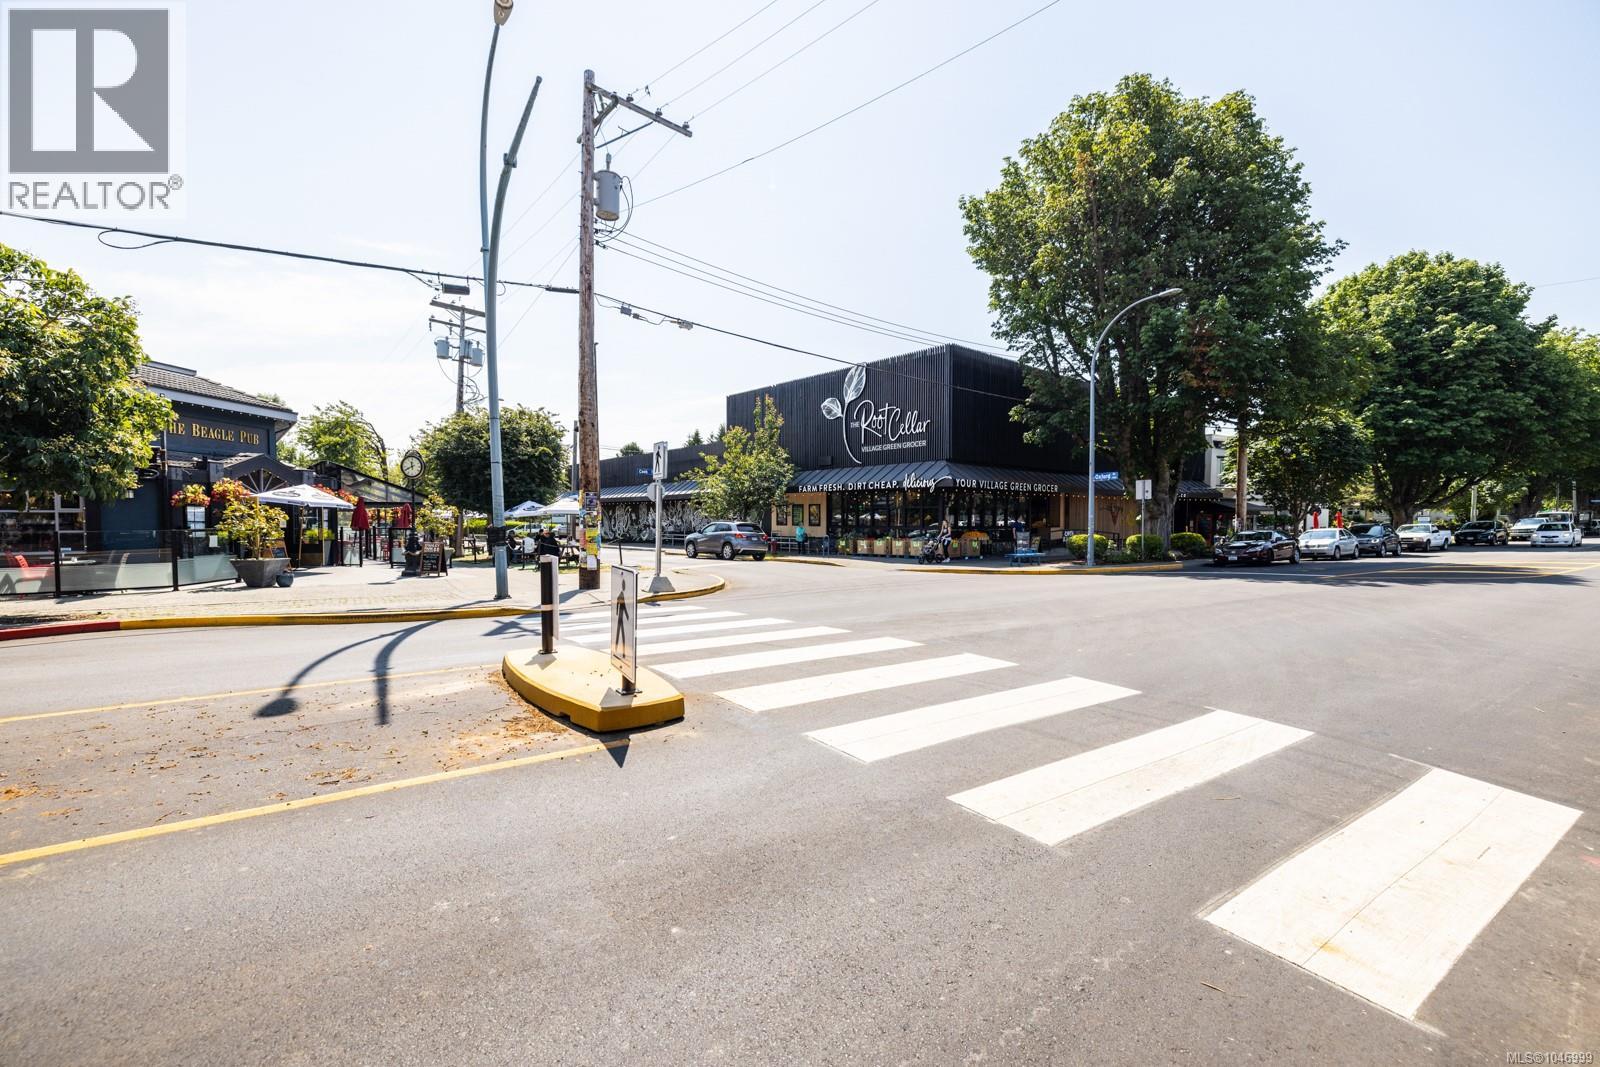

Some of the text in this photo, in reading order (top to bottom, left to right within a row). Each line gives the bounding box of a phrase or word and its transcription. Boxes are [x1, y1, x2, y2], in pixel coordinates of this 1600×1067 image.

[854, 399, 896, 444] Root
[888, 408, 931, 441] Cellar
[169, 422, 259, 445] HE BEAGLE PUB
[861, 440, 927, 453] VILLAGE GREEN GROCER
[798, 472, 951, 493] FARM FRESH. DIRT CHEAP. delicious
[955, 478, 1058, 493] YOUR VILLAGE GREEN GROCER
